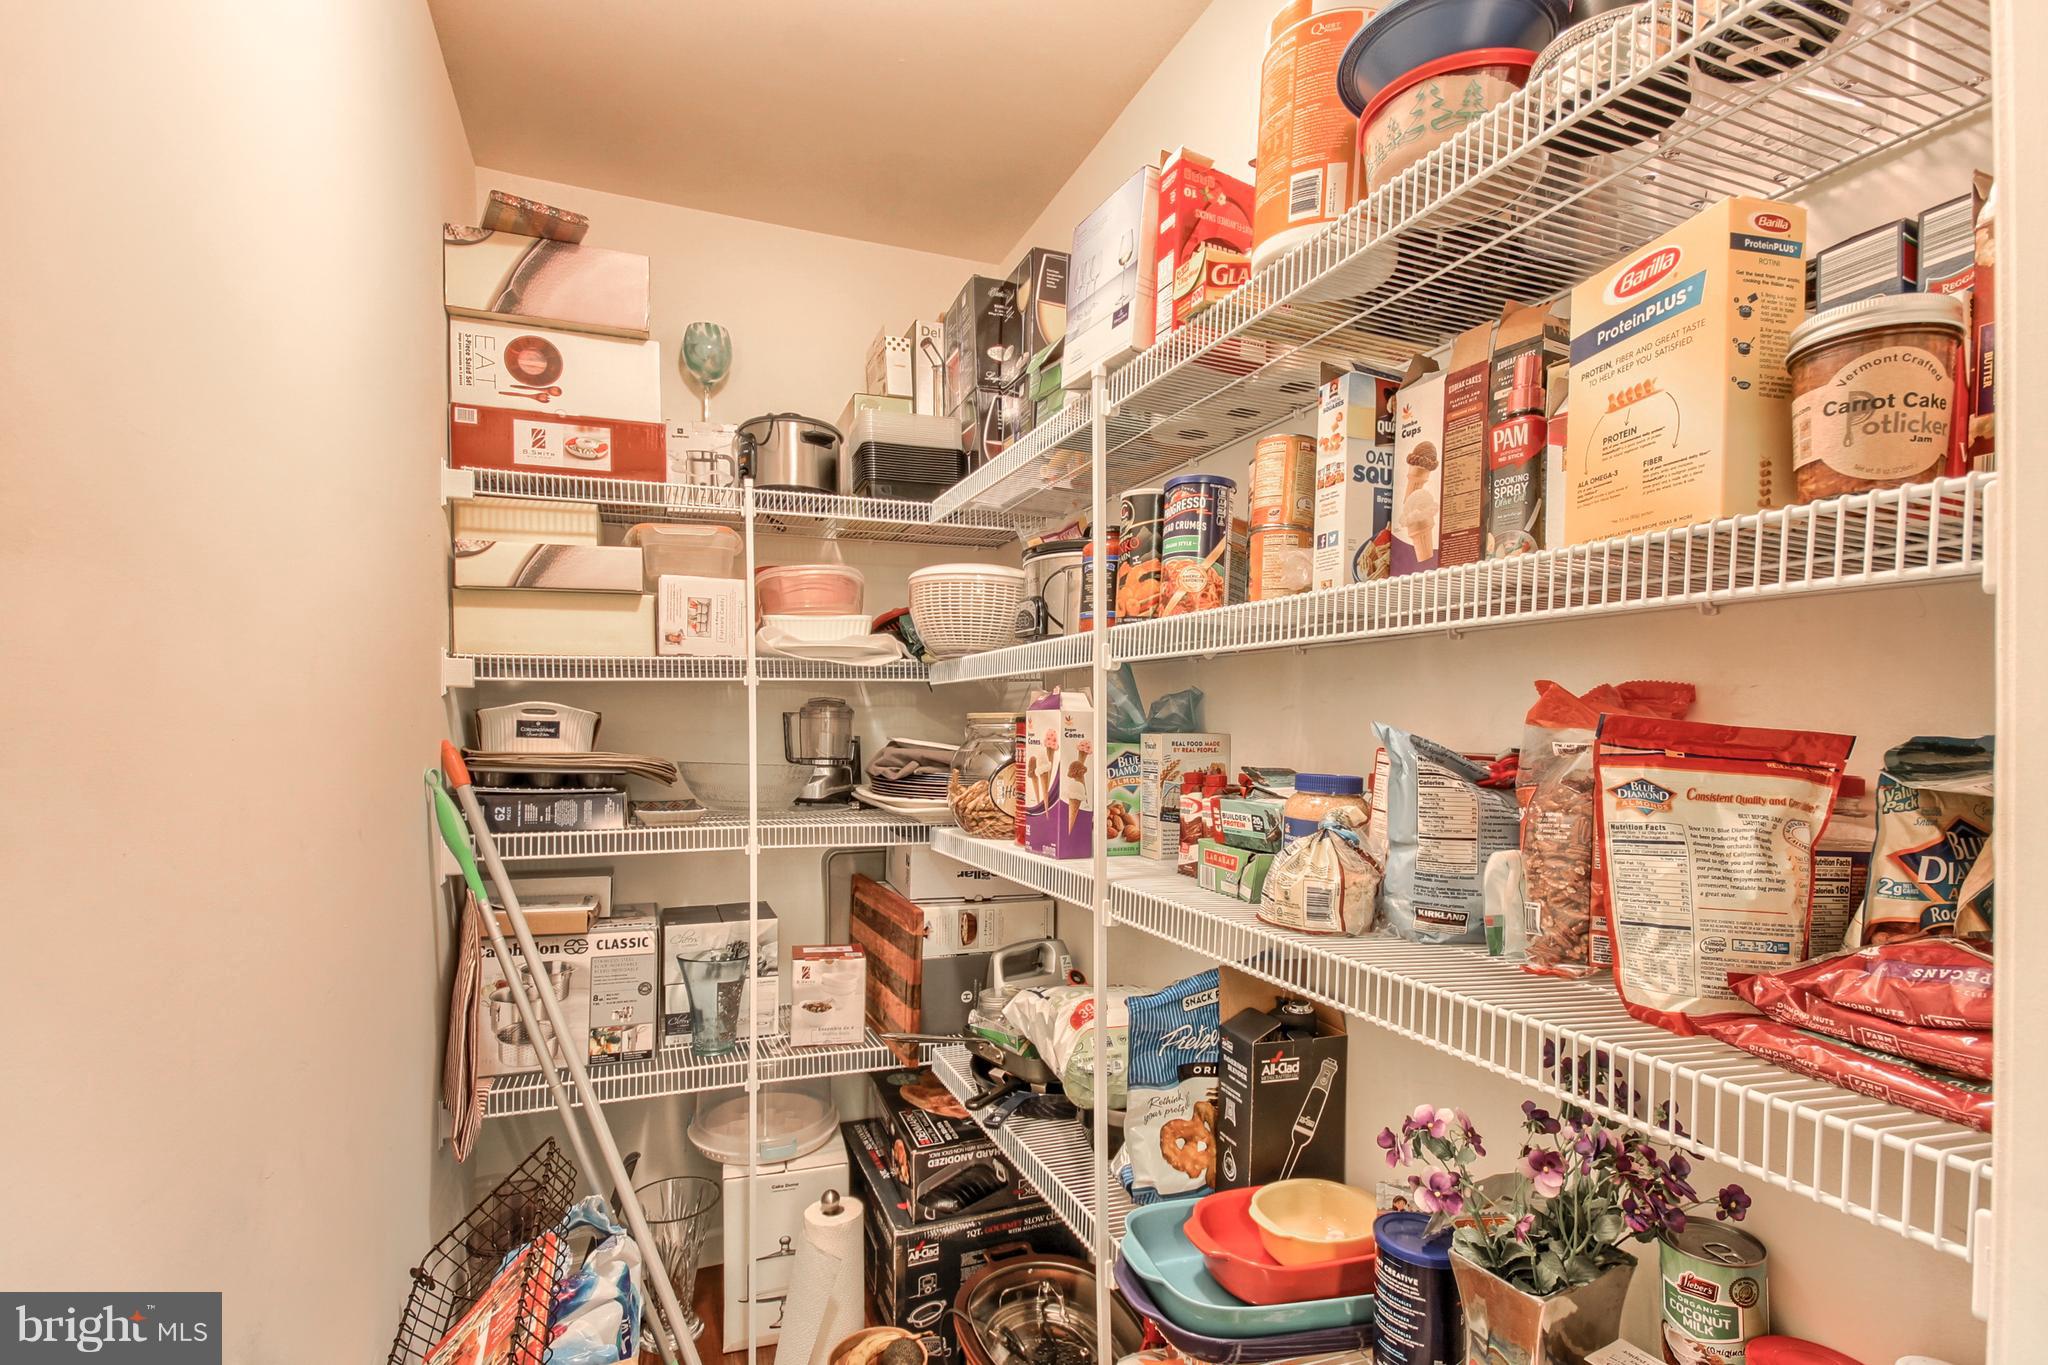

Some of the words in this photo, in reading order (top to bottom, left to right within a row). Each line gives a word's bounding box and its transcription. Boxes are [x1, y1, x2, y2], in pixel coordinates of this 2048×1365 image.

[1758, 216, 1788, 230] Barilla
[1210, 264, 1250, 286] GLA
[1620, 252, 1675, 293] Barilla
[921, 325, 941, 339] Del
[1581, 360, 1613, 382] PROTEIN,
[1615, 350, 1634, 365] FIBER
[1636, 342, 1652, 356] AND
[1654, 330, 1680, 347] GREAT
[1682, 318, 1706, 333] TASTE
[465, 357, 473, 376] Salad
[475, 334, 497, 390] EAT
[1588, 378, 1598, 388] TO
[1599, 369, 1616, 383] HELP
[1617, 361, 1634, 375] KEEP
[1635, 352, 1652, 367] YOU
[1836, 353, 1898, 388] Vermont
[1902, 352, 1943, 382] Crafted
[1983, 351, 1993, 389] BUTTER
[1823, 393, 1896, 417] Carrot
[1903, 391, 1947, 411] Cake
[1401, 426, 1422, 440] Cups
[1493, 423, 1529, 453] PAM
[1602, 426, 1638, 446] PROTEIN
[1909, 434, 1933, 443] Jam
[1366, 450, 1392, 465] OAT
[1642, 455, 1663, 467] FIBER
[1353, 464, 1392, 486] SQU
[1494, 473, 1530, 488] COOKING
[1577, 479, 1589, 489] ALA
[1589, 469, 1618, 484] OMEGA-3
[1494, 482, 1529, 500] SPRAY
[1175, 521, 1207, 532] CRUMBS
[1027, 737, 1041, 745] Cones
[1118, 755, 1140, 767] BLUE
[1630, 781, 1656, 793] BLUE
[1617, 789, 1669, 801] DIAMOND
[1686, 787, 1733, 803] Consistent
[1735, 794, 1767, 806] Quality
[1769, 797, 1786, 806] and
[1621, 800, 1670, 811] ALMONDS
[1883, 797, 1919, 814] Pack
[494, 806, 506, 821] 62
[1222, 820, 1246, 828] PROTEIN
[1711, 834, 1738, 843] producing
[1206, 852, 1235, 865] LARABAR
[1815, 859, 1836, 867] utrition
[1836, 858, 1851, 867] Facts
[1835, 885, 1850, 894] 160
[1878, 878, 1903, 896] 2g
[1417, 909, 1466, 921] KIRKLAND
[596, 937, 649, 950] CLASSIC
[1912, 968, 1992, 985] PECANS
[1184, 992, 1213, 1008] SNACK
[1880, 1006, 1905, 1018] NUTS
[1812, 1015, 1835, 1027] NUTS
[1865, 1031, 1893, 1043] FARM
[1749, 1045, 1793, 1061] DIAMOND
[1796, 1056, 1820, 1071] NUTS
[1193, 1066, 1216, 1075] ORI
[1261, 1061, 1300, 1076] All-Clad
[1854, 1079, 1884, 1093] FARM
[1148, 1091, 1184, 1110] Rethink
[1143, 1109, 1163, 1125] your
[927, 1152, 974, 1168] ANODIZED
[1023, 1215, 1045, 1225] SLOW
[1008, 1226, 1023, 1234] WITH
[908, 1247, 939, 1261] All-Clad
[1383, 1263, 1419, 1286] CREATIVE
[1680, 1273, 1714, 1296] Lieber's
[1677, 1294, 1720, 1316] ORGANIC
[1669, 1297, 1732, 1330] COCONUT
[1682, 1318, 1714, 1337] MILK
